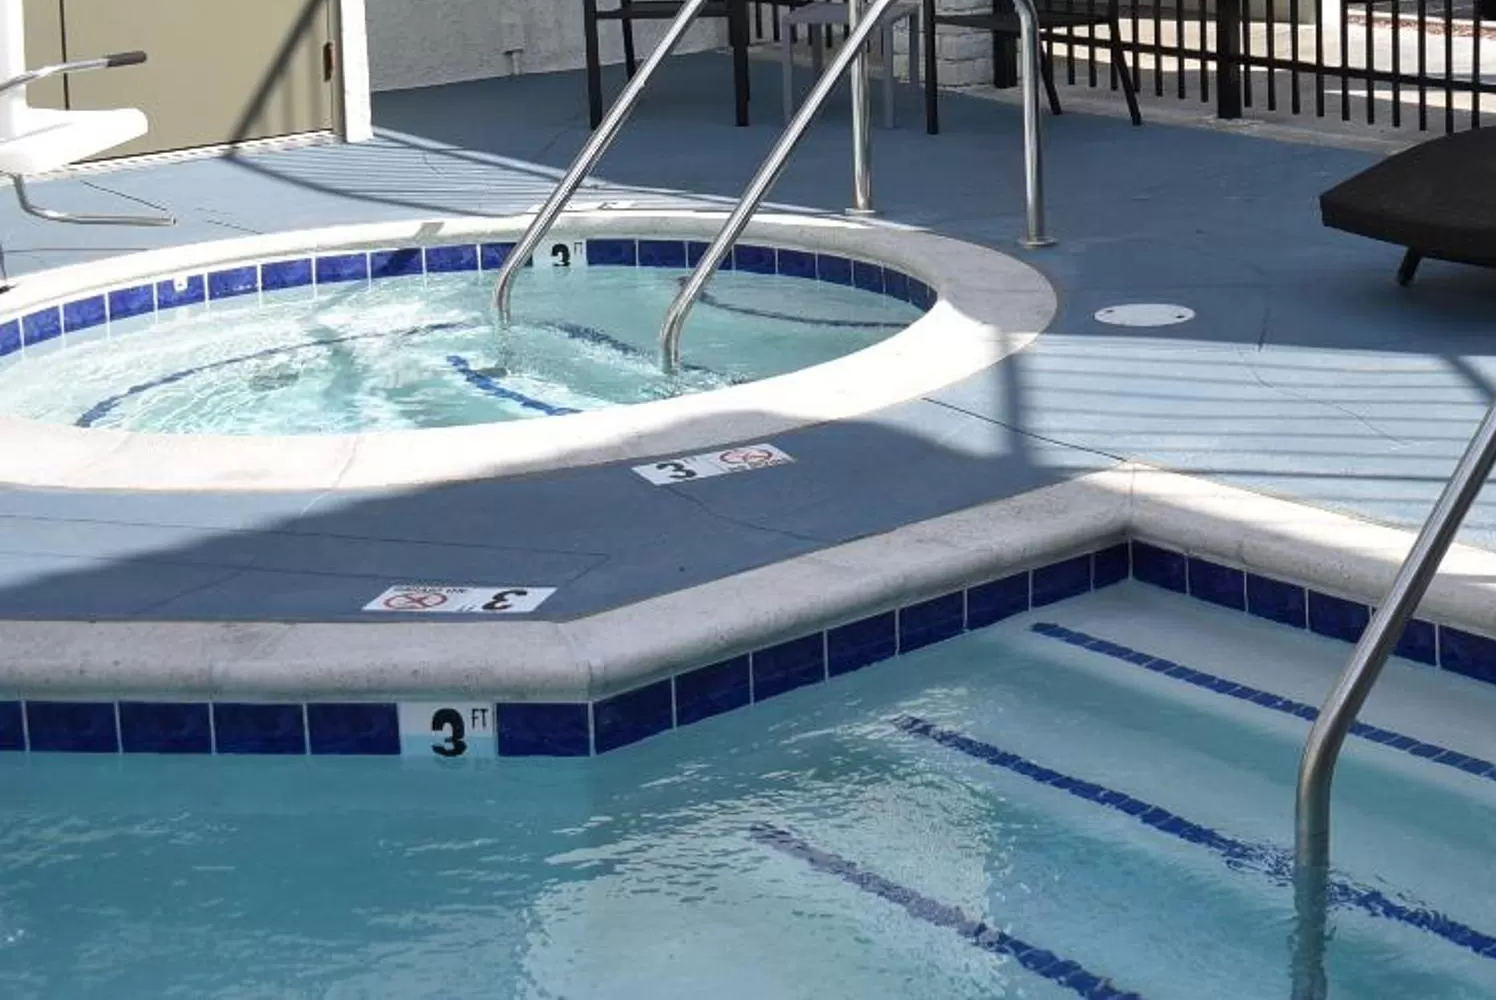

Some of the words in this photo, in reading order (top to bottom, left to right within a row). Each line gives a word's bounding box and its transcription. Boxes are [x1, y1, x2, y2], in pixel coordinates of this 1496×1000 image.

[551, 243, 570, 267] 3
[656, 462, 697, 479] 3
[482, 590, 527, 610] 3
[431, 708, 467, 757] 3
[471, 708, 489, 729] FT
